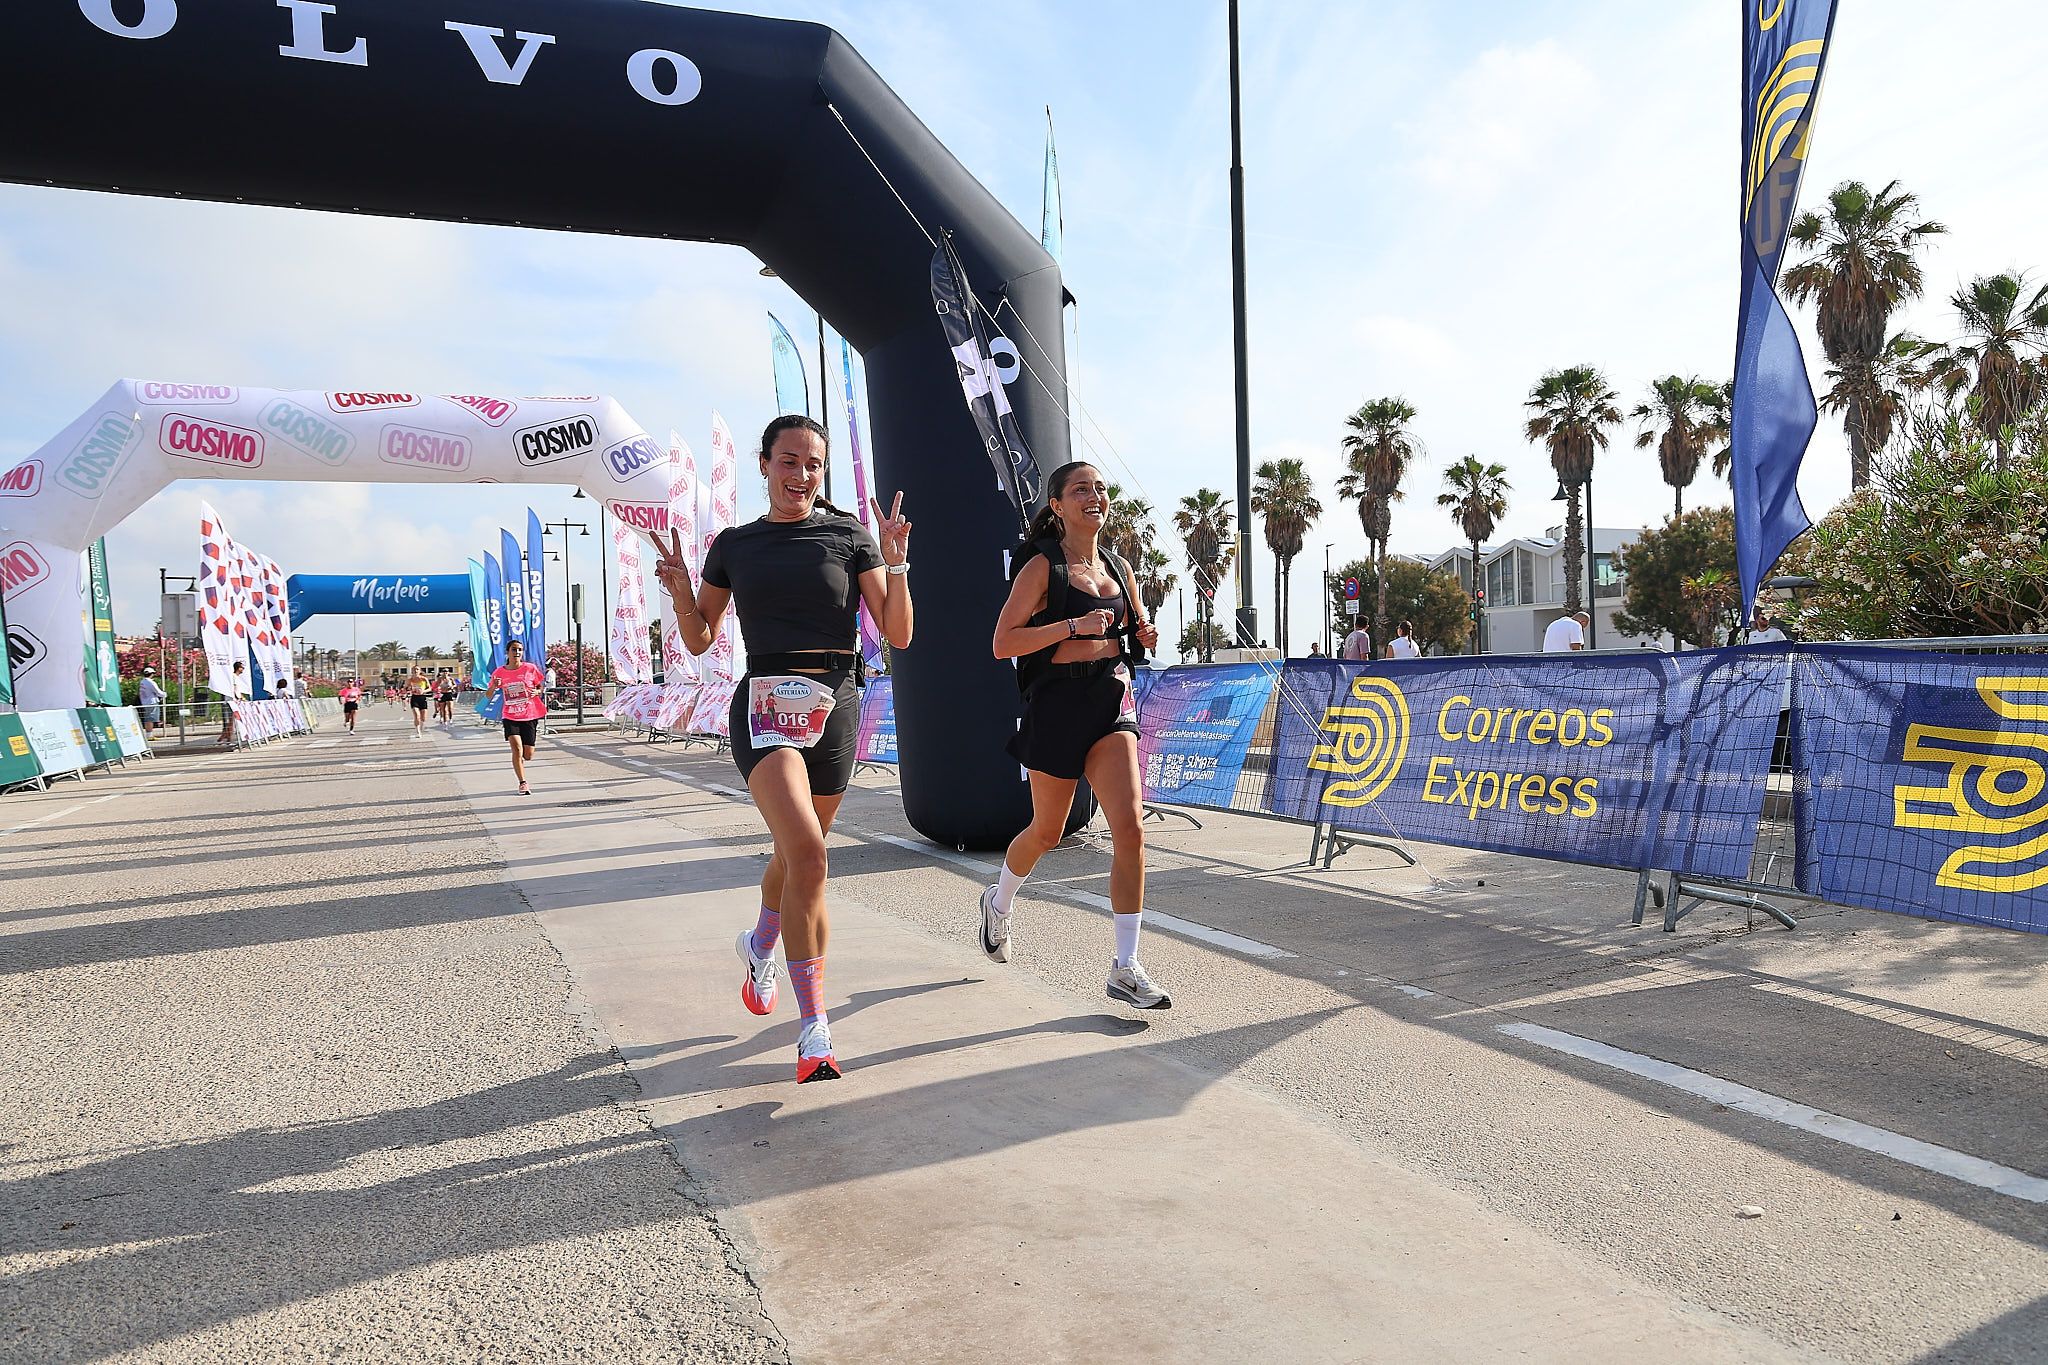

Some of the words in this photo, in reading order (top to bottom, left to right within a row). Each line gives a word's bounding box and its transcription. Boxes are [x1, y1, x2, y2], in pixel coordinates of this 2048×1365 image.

[77, 0, 702, 105] OLVO
[145, 382, 231, 400] COSMO
[169, 420, 256, 463] COSMO
[267, 403, 348, 460] COSMO
[388, 430, 464, 466] COSMO
[522, 420, 593, 460] COSMO
[64, 418, 135, 490] COSMO
[352, 578, 429, 608] Marlene
[776, 687, 809, 695] ASTURIANA
[778, 712, 809, 726] 016
[1438, 695, 1615, 748] Correos
[1422, 756, 1599, 821] Express
